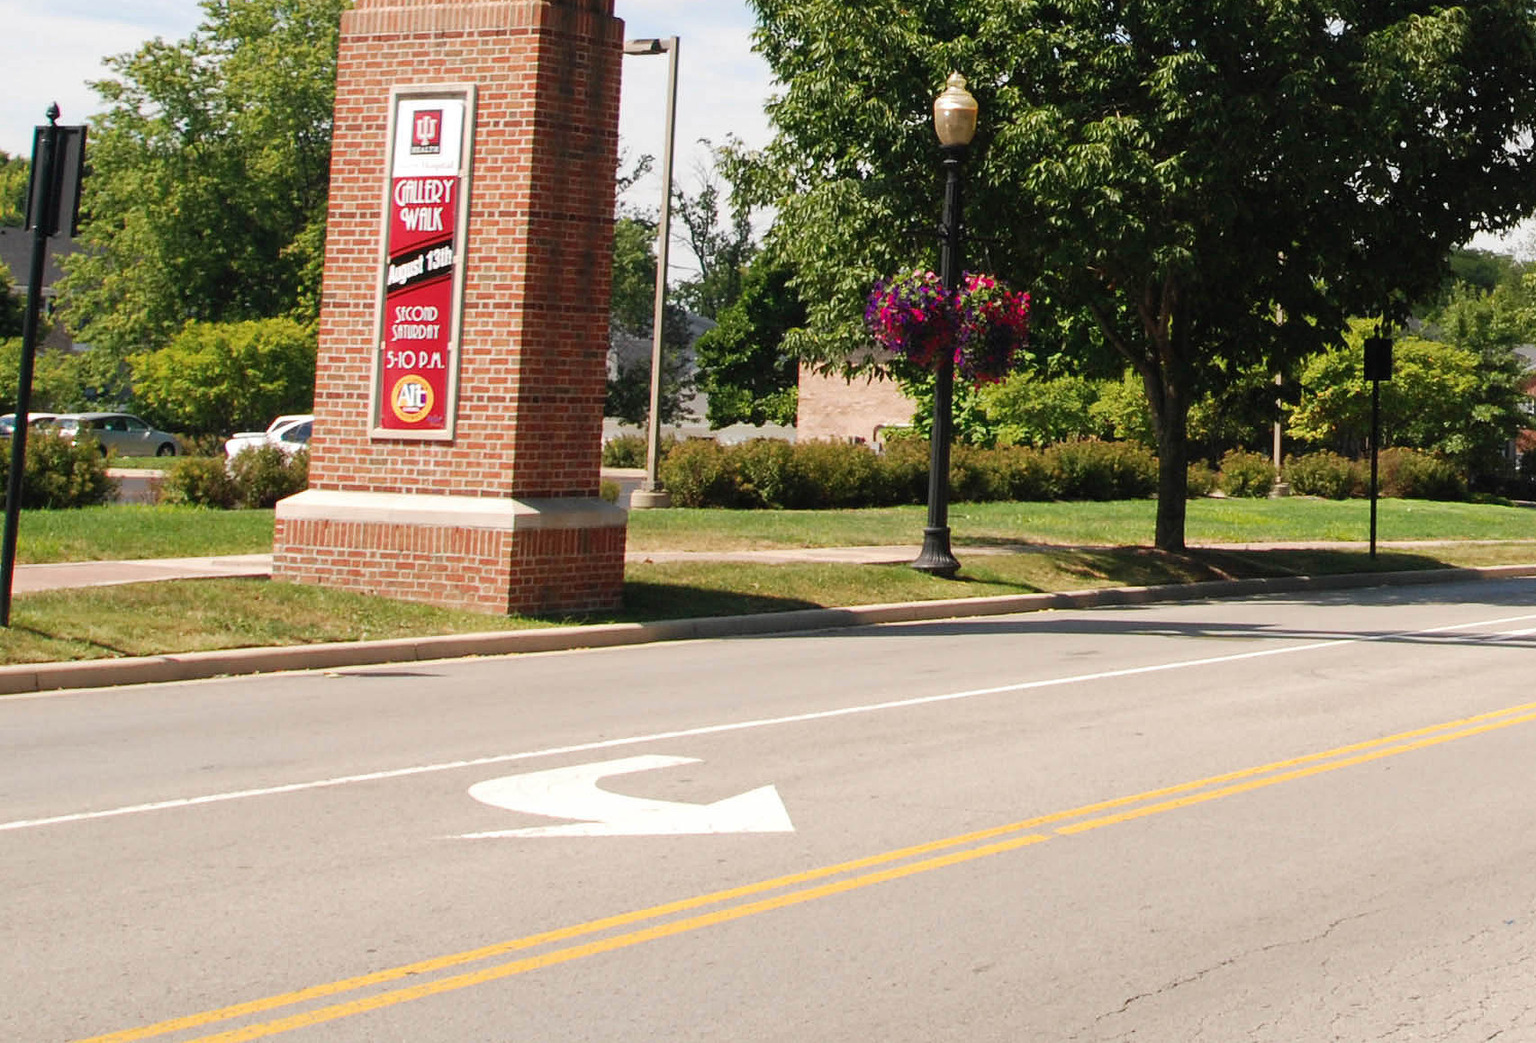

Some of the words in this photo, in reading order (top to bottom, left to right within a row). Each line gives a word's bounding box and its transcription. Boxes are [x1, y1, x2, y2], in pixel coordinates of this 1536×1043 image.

[394, 179, 455, 207] GALLERY
[400, 207, 444, 232] WALK
[387, 253, 424, 286] August
[394, 306, 439, 323] SECOND
[391, 324, 440, 341] SATURDAY
[386, 350, 416, 369] 5-10
